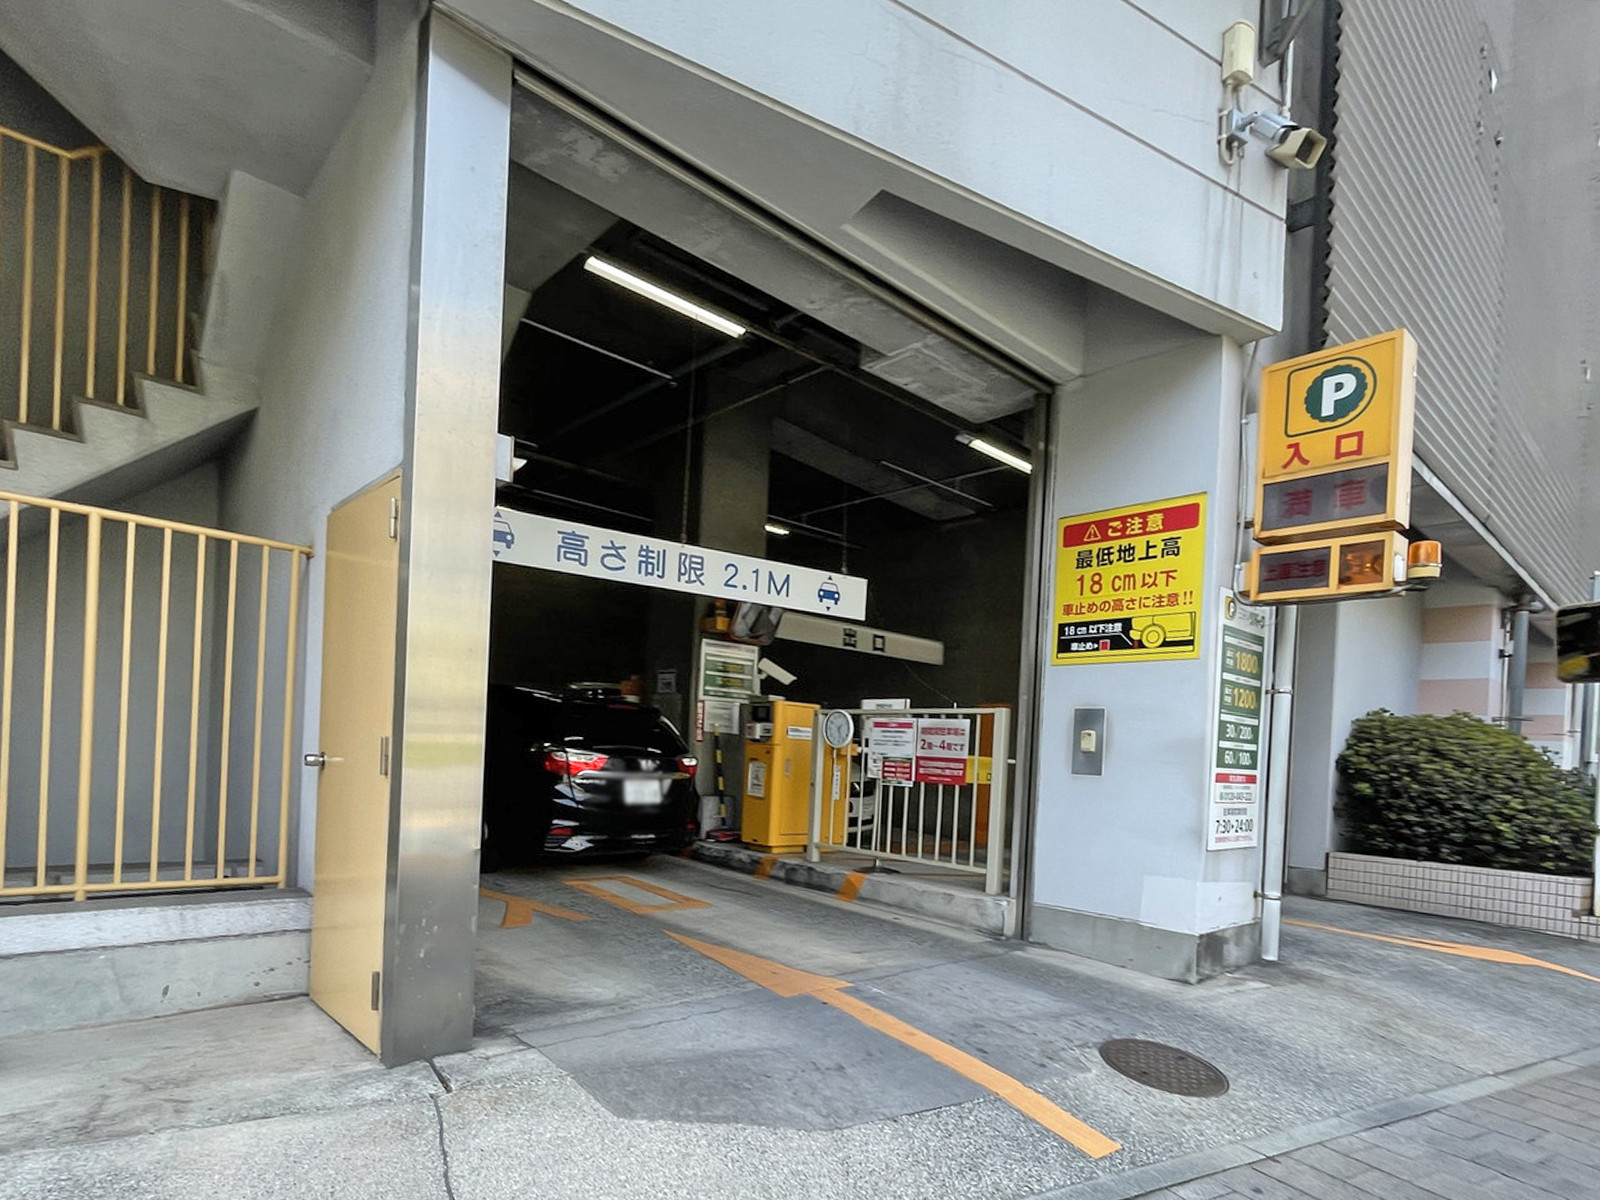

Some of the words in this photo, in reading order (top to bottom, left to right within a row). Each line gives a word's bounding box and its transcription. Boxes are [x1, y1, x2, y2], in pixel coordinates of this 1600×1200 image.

[1321, 372, 1357, 417] P
[1281, 430, 1364, 469] 入口
[1107, 513, 1164, 537] ご注意
[556, 530, 705, 586] 高さ制限
[723, 563, 791, 597] 2.1M
[1075, 536, 1182, 570] 最低地上高
[842, 628, 885, 652] 出口
